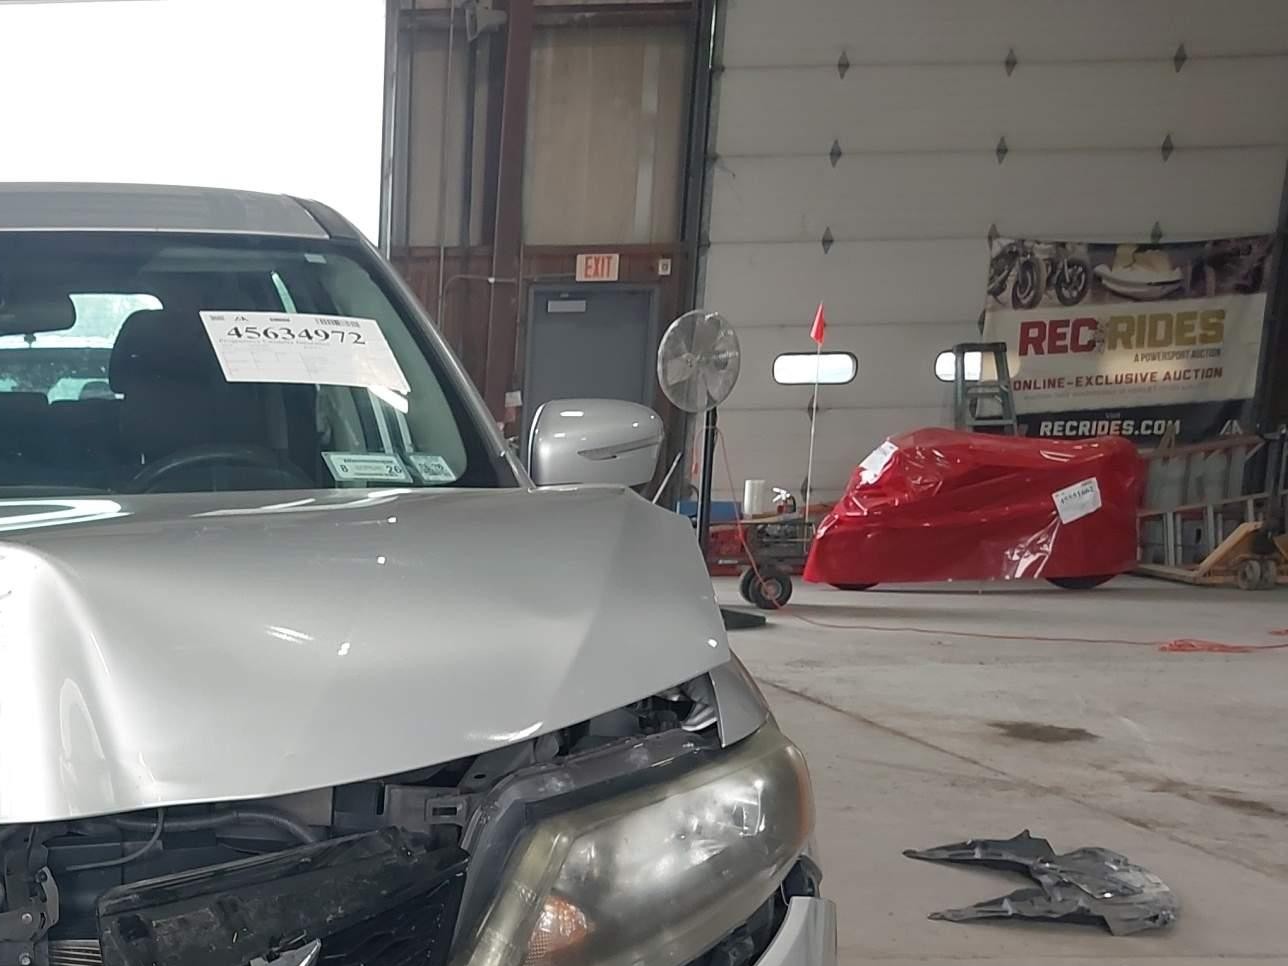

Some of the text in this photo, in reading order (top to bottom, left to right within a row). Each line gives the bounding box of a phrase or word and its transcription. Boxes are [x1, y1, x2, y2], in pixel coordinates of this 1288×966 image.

[584, 256, 612, 279] EXIT
[227, 326, 365, 346] 45634972
[1019, 310, 1225, 356] REC RIDES
[1141, 350, 1191, 362] POWERSPORT
[1013, 372, 1158, 391] ONLINE-EXCLUSIVE
[1163, 367, 1223, 382] AUCTION
